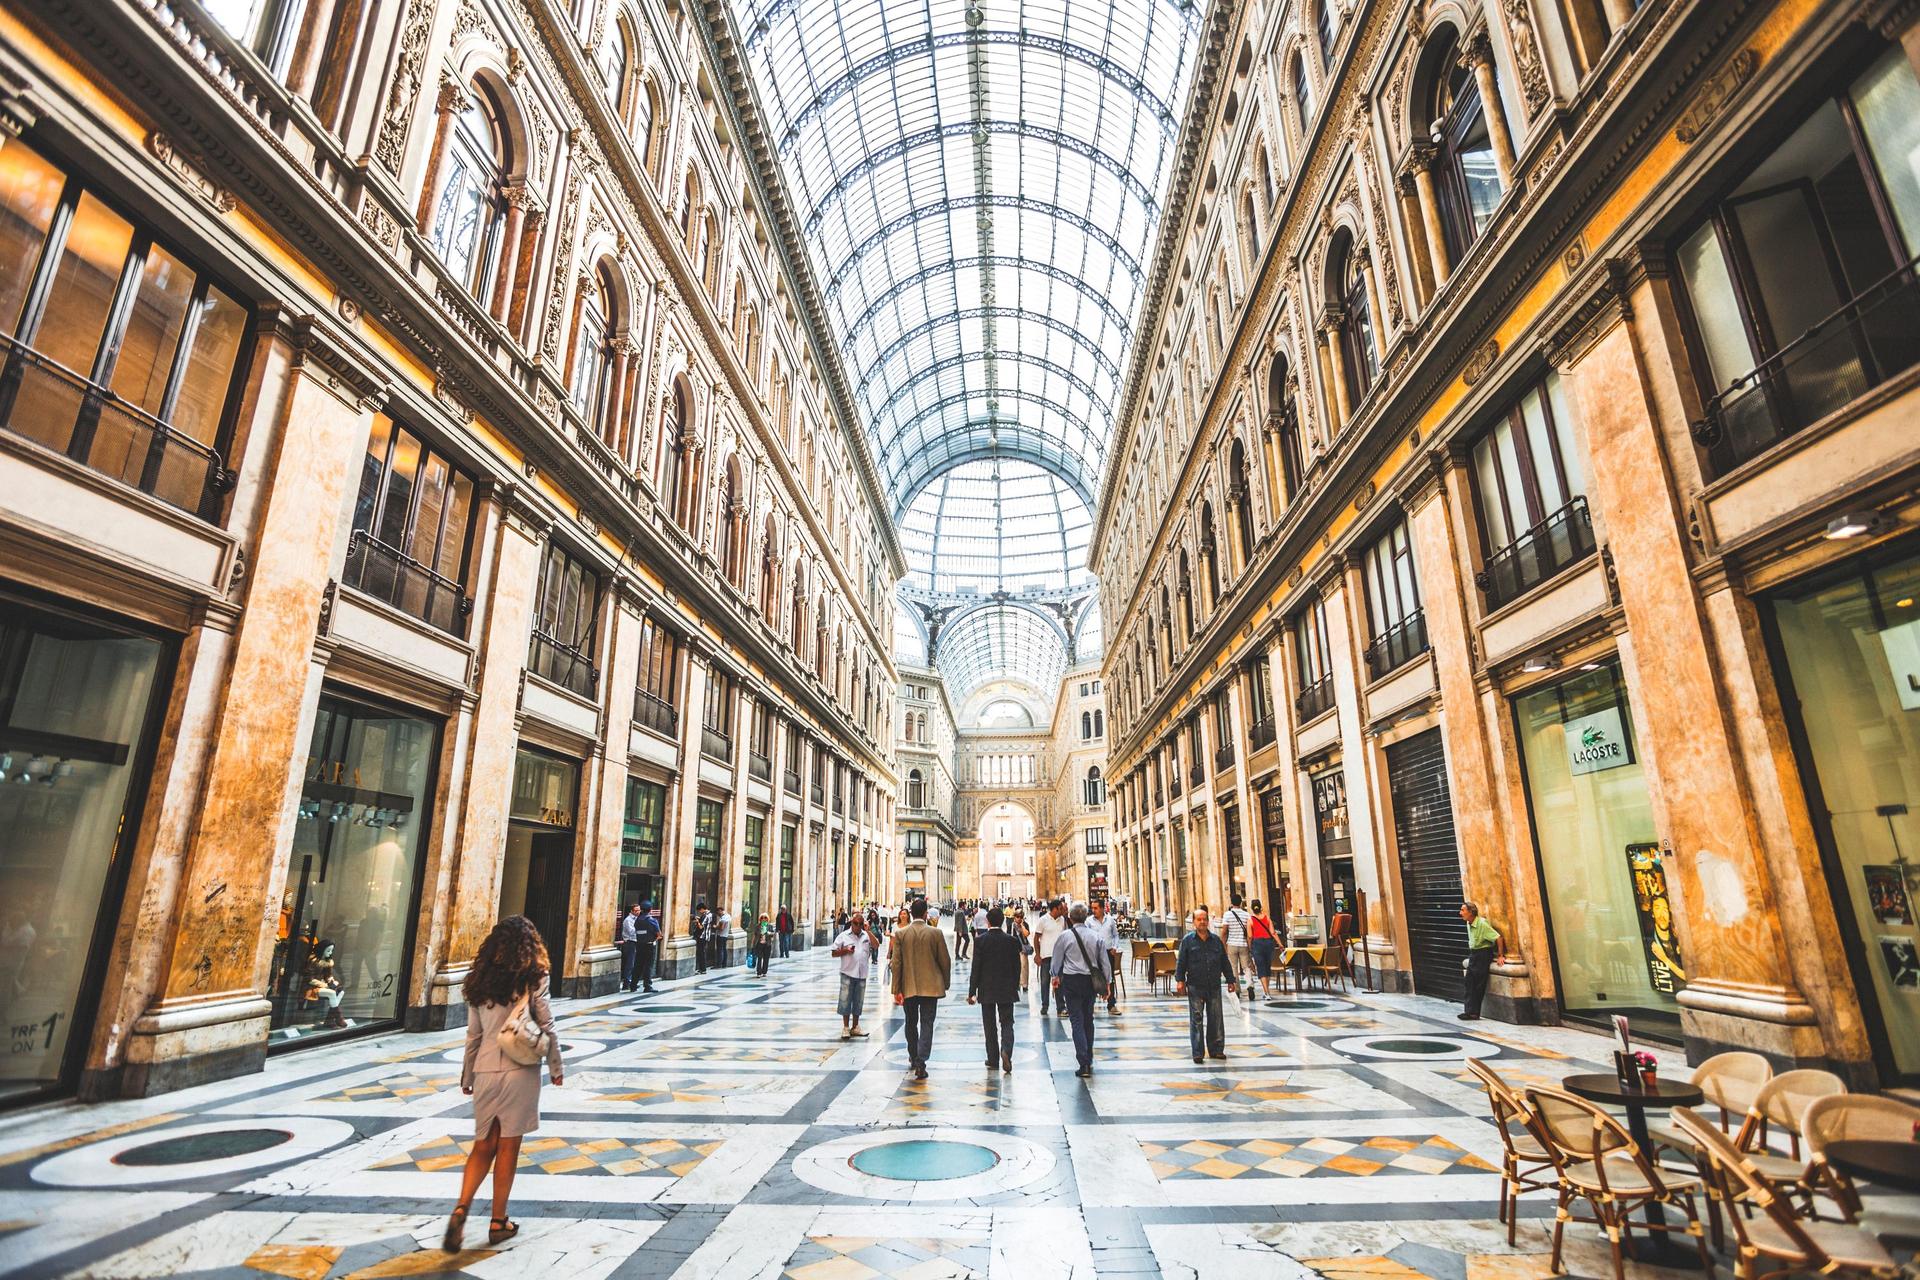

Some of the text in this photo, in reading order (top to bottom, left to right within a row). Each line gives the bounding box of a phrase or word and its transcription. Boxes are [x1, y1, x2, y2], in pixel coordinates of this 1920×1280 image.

[1573, 742, 1620, 764] LACOSTE
[541, 807, 572, 827] ZARA
[11, 1024, 38, 1039] TRF
[11, 1040, 35, 1054] ON
